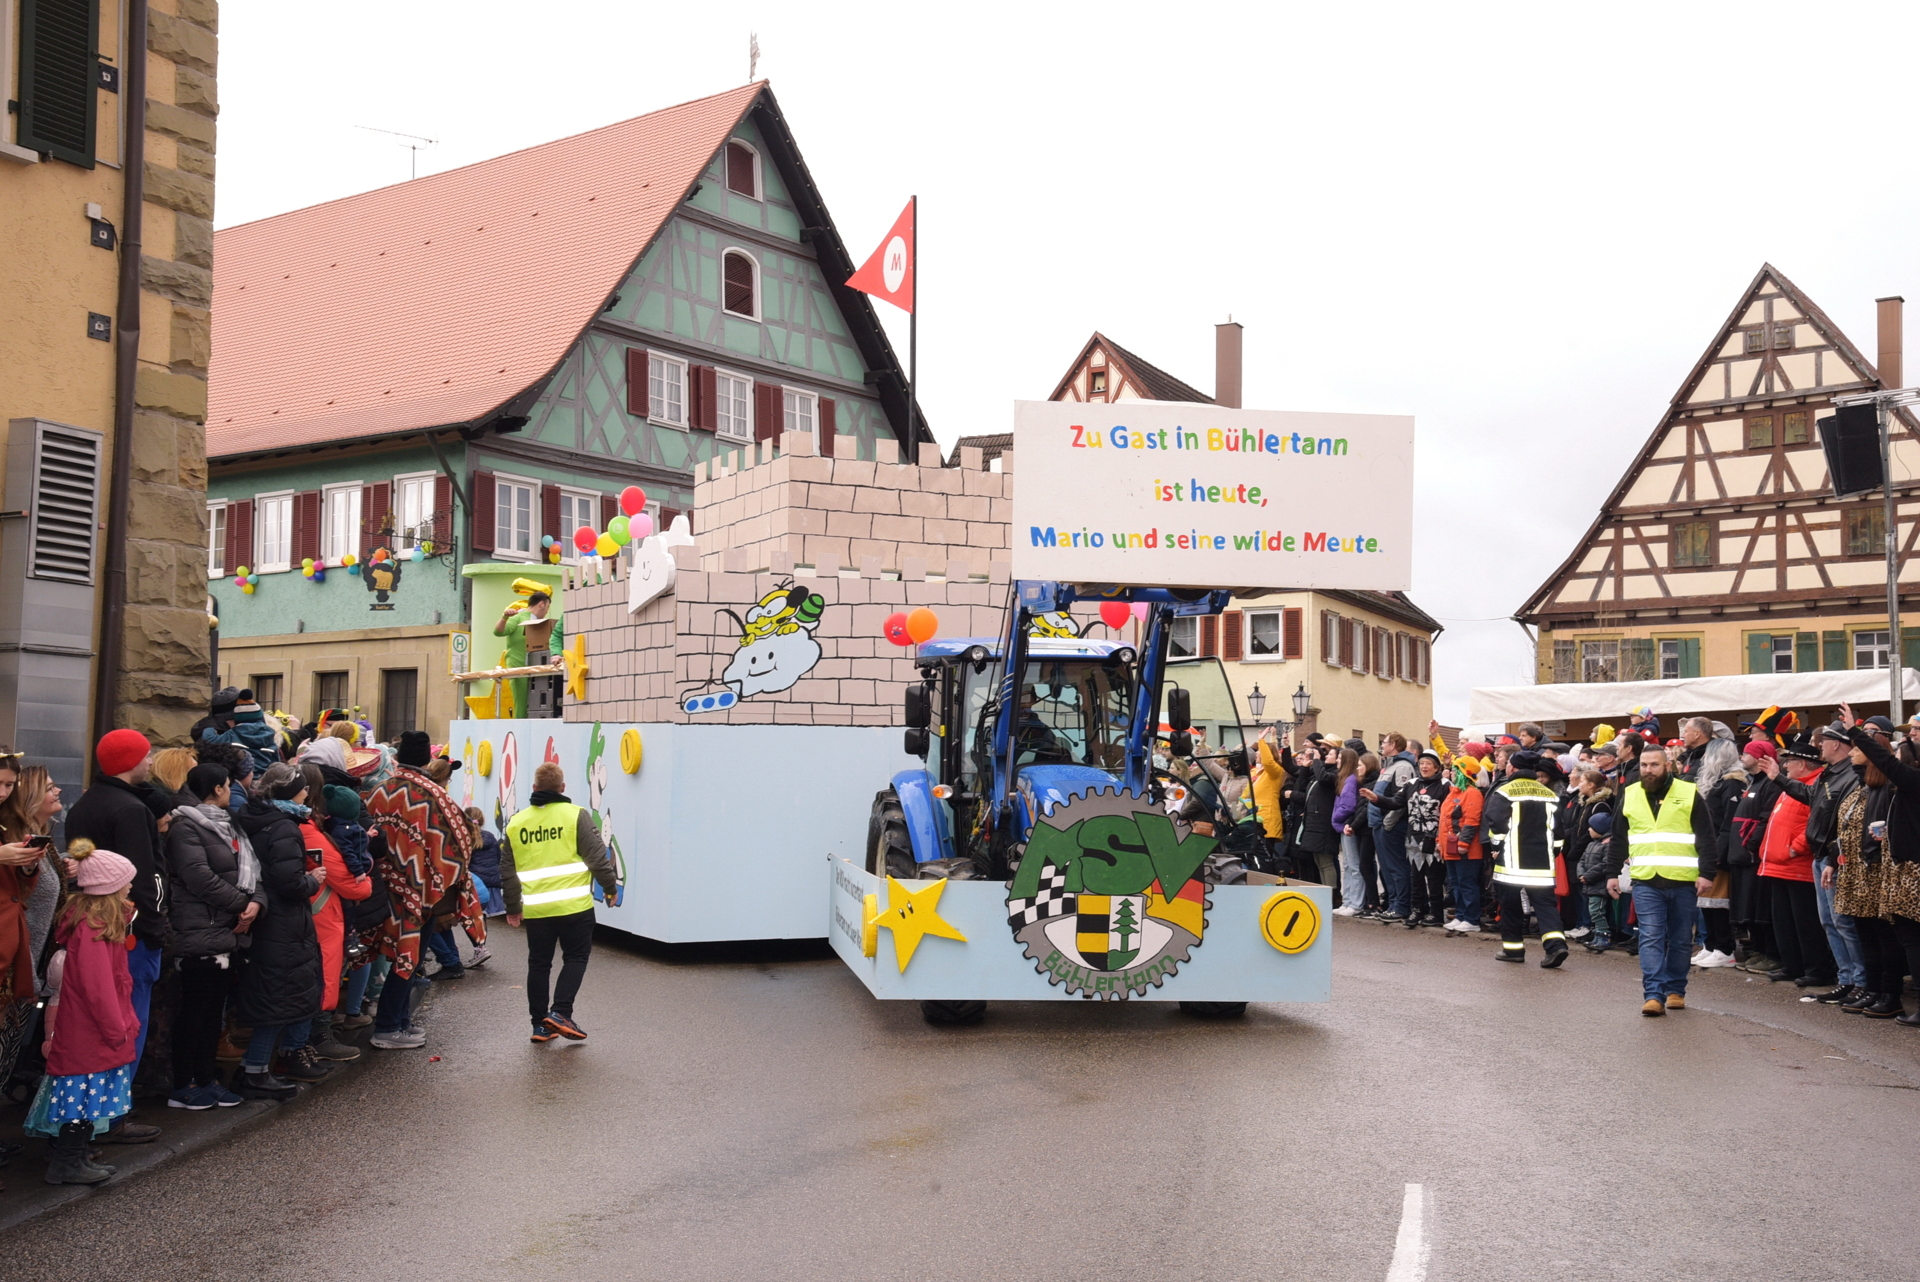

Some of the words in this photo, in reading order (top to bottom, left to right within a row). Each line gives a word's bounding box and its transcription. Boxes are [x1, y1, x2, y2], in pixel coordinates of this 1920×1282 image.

[891, 253, 902, 271] M
[1070, 425, 1102, 448] Zu
[1110, 425, 1168, 450] Gast
[1176, 426, 1199, 450] in
[1207, 427, 1348, 456] Bühlertann
[1154, 479, 1184, 501] ist
[1191, 478, 1269, 508] heute,
[1030, 526, 1104, 548] Mario
[1112, 527, 1158, 549] und
[1165, 529, 1226, 550] seine
[1233, 530, 1296, 552] wilde
[1303, 531, 1384, 554] Meute.
[456, 638, 464, 649] H
[520, 825, 563, 845] Ordner
[1008, 811, 1220, 905] MSV
[1043, 950, 1175, 991] Bühlertann
